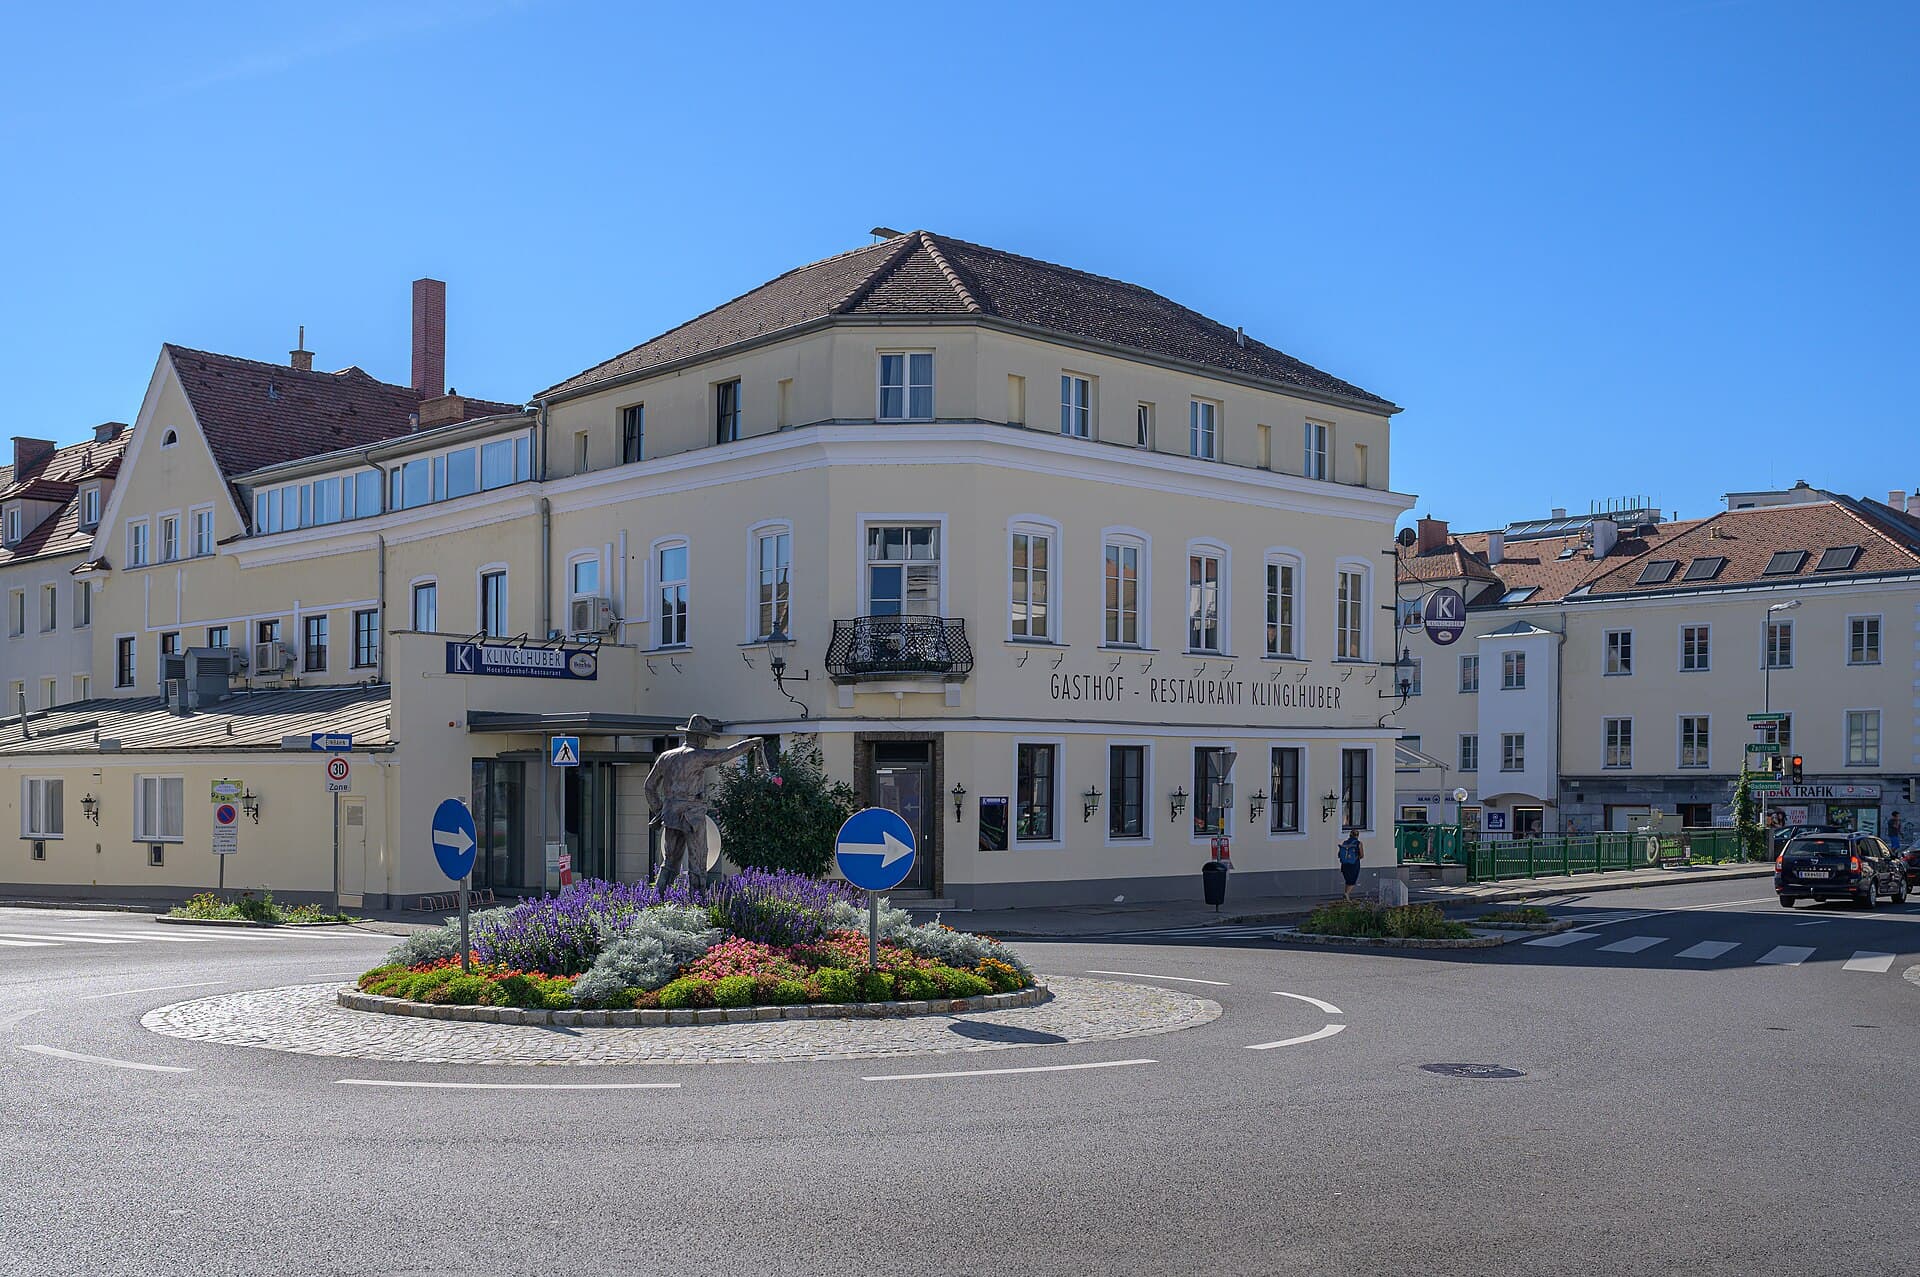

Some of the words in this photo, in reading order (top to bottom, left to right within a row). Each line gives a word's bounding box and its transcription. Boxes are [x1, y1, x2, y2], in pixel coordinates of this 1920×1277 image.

[1439, 598, 1453, 618] K
[457, 646, 472, 670] K
[486, 651, 561, 667] KLINGLHUBER
[1050, 674, 1124, 702] GASTHOF
[1151, 678, 1243, 705] RESTAURANT
[1252, 682, 1341, 710] KLINGLHUBER
[1751, 744, 1777, 752] Zentrum
[333, 763, 345, 776] 30
[329, 783, 348, 791] Zone
[1794, 786, 1833, 797] TRAFIK
